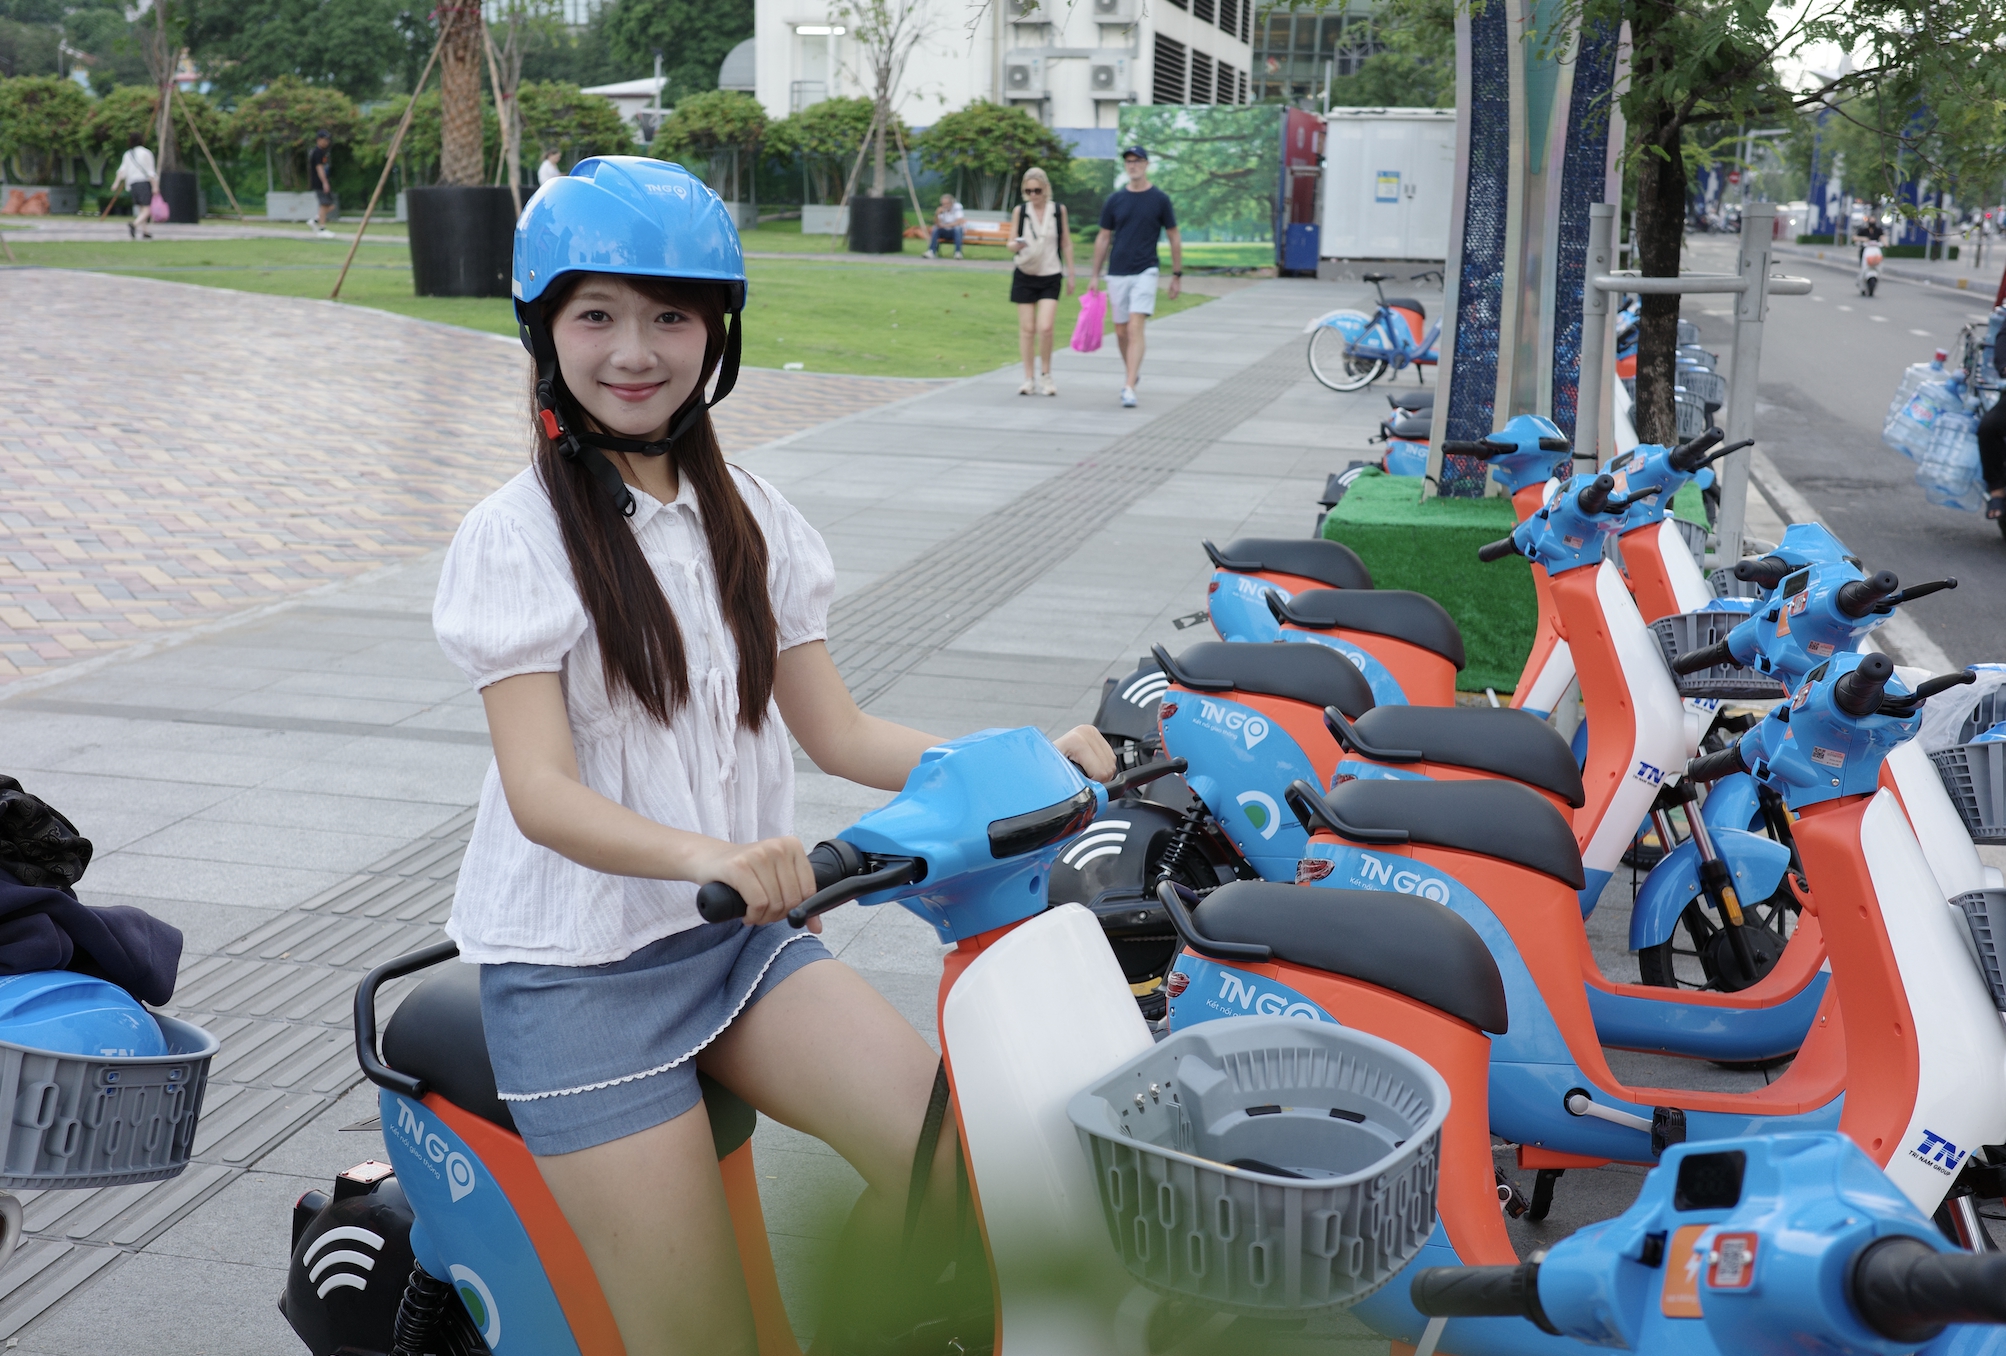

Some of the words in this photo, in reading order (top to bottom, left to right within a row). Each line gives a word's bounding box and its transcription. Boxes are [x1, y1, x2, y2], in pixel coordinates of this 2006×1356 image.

[1637, 761, 1665, 784] TN
[1205, 998, 1219, 1010] Kết
[1219, 1006, 1233, 1016] nối
[1917, 1129, 1966, 1170] TN
[1908, 1149, 1919, 1159] TRI
[1918, 1156, 1934, 1167] NAM
[1933, 1164, 1952, 1176] GROUP
